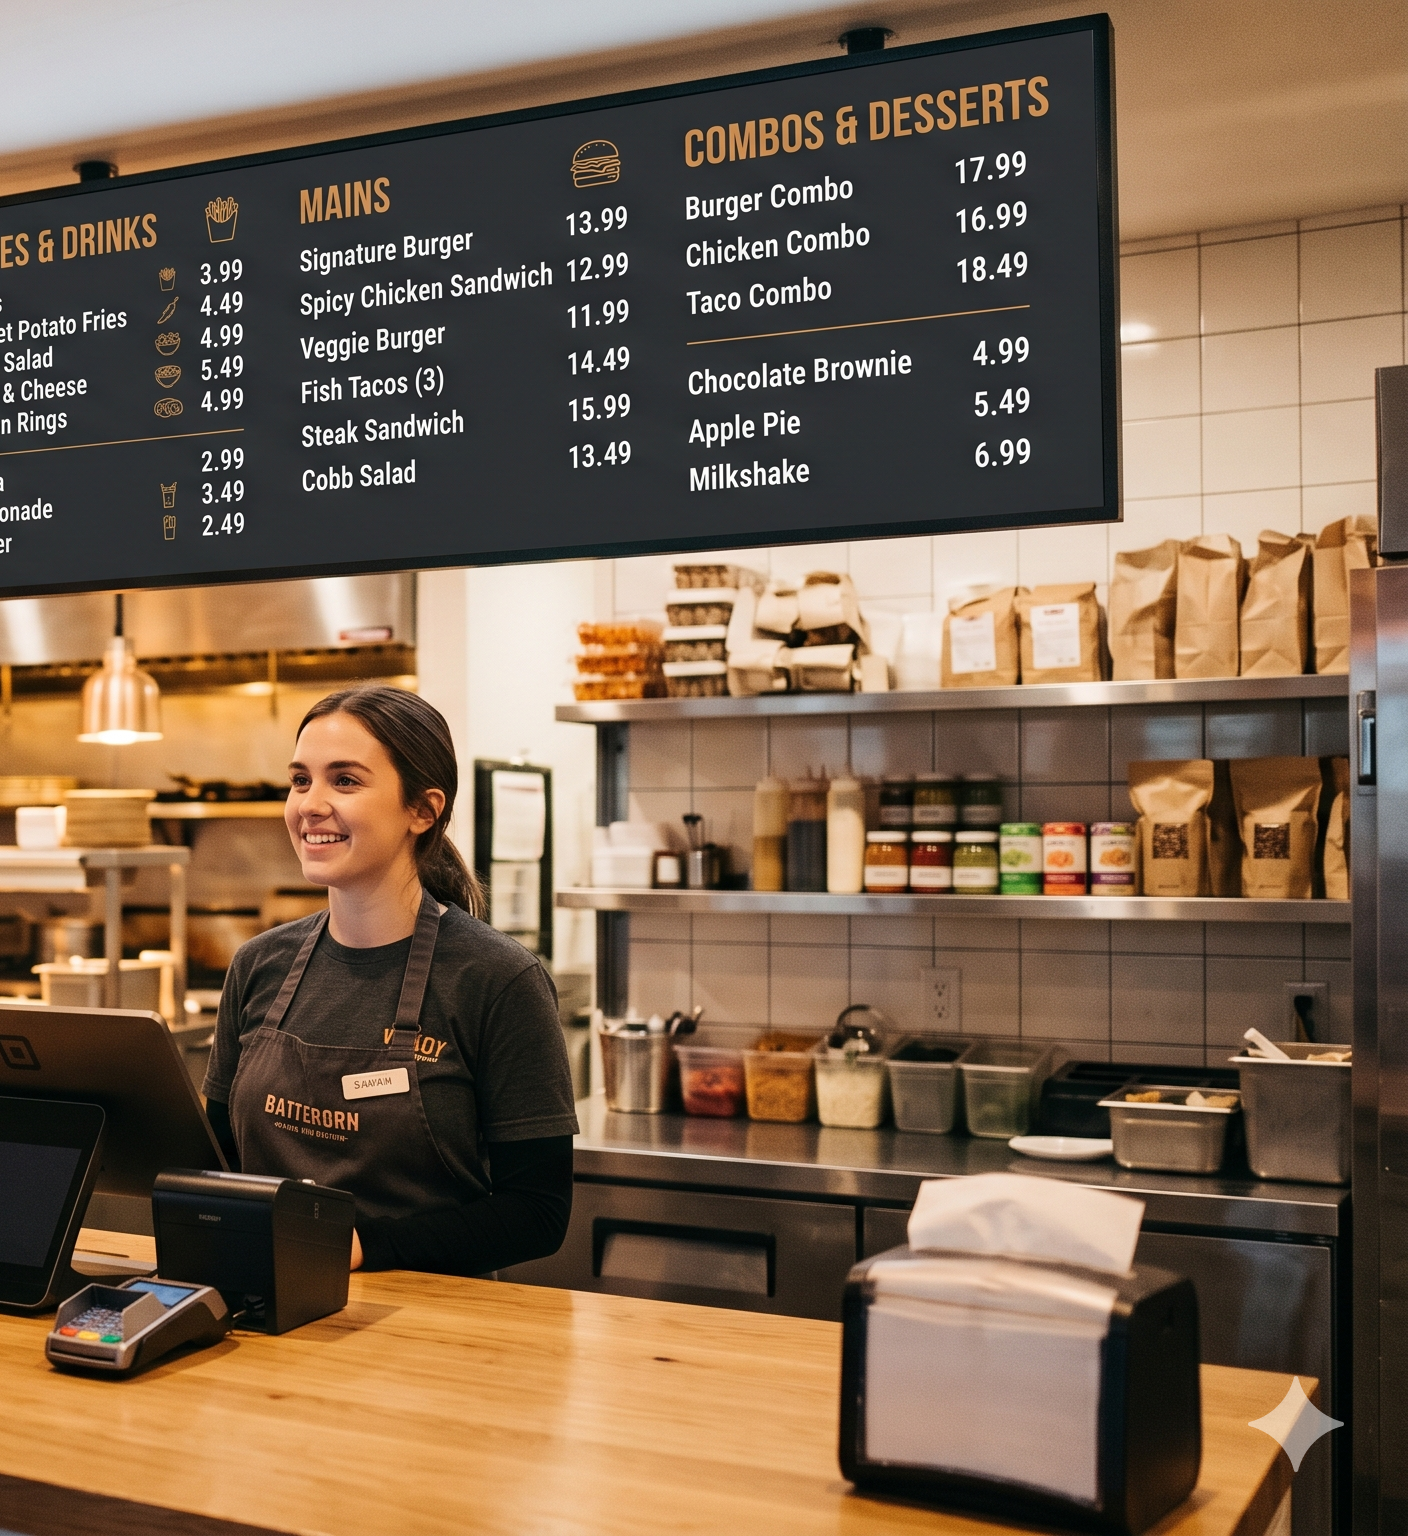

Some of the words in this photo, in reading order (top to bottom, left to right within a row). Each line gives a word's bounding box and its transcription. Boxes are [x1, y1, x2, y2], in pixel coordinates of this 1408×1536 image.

[684, 110, 825, 168] COMBOS
[835, 105, 858, 146] &
[869, 75, 1050, 141] DESSERTS
[955, 150, 1027, 184] 17.99
[300, 176, 391, 225] MAINS
[685, 191, 763, 222] Burger
[770, 175, 854, 209] Combo
[565, 205, 628, 237] 13.99
[955, 200, 1028, 234] 16.99
[38, 229, 55, 264] &
[62, 213, 158, 260] DRINKS
[299, 242, 397, 276] Signature
[403, 231, 474, 260] Burger
[686, 235, 779, 268] Chicken
[786, 222, 871, 255] Combo
[200, 258, 243, 286] 3.99
[566, 251, 629, 283] 12.99
[956, 250, 1028, 284] 18.49
[199, 290, 244, 317] 4.49
[299, 289, 355, 321] Spicy
[360, 278, 443, 309] Chicken
[450, 261, 553, 298] Sandwich
[685, 290, 742, 315] Taco
[749, 275, 832, 308] Combo
[18, 315, 77, 341] Potato
[82, 308, 128, 333] Fries
[567, 298, 630, 329] 11.99
[200, 322, 244, 349] 4.99
[299, 330, 370, 363] Veggie
[376, 325, 446, 354] Burger
[972, 336, 1030, 366] 4.99
[3, 345, 53, 373] Salad
[201, 354, 244, 381] 5.49
[567, 345, 630, 376] 14.49
[688, 362, 806, 396] Chocolate
[813, 349, 913, 383] Brownie
[2, 382, 15, 404] &
[20, 378, 88, 402] Cheese
[200, 387, 244, 413] 4.99
[301, 376, 343, 404] Fish
[347, 375, 409, 399] Tacos
[415, 365, 444, 399] (3)
[568, 392, 631, 422] 15.99
[974, 386, 1031, 418] 5.49
[17, 410, 68, 436] Rings
[301, 419, 359, 448] Steak
[364, 408, 464, 442] Sandwich
[688, 413, 756, 449] Apple
[763, 409, 801, 437] Pie
[201, 447, 245, 473] 2.99
[568, 440, 632, 469] 13.49
[974, 437, 1031, 468] 6.99
[302, 464, 354, 492] Cobb
[359, 458, 416, 487] Salad
[689, 457, 810, 492] Milkshake
[201, 479, 245, 505] 3.49
[201, 511, 245, 537] 2.49
